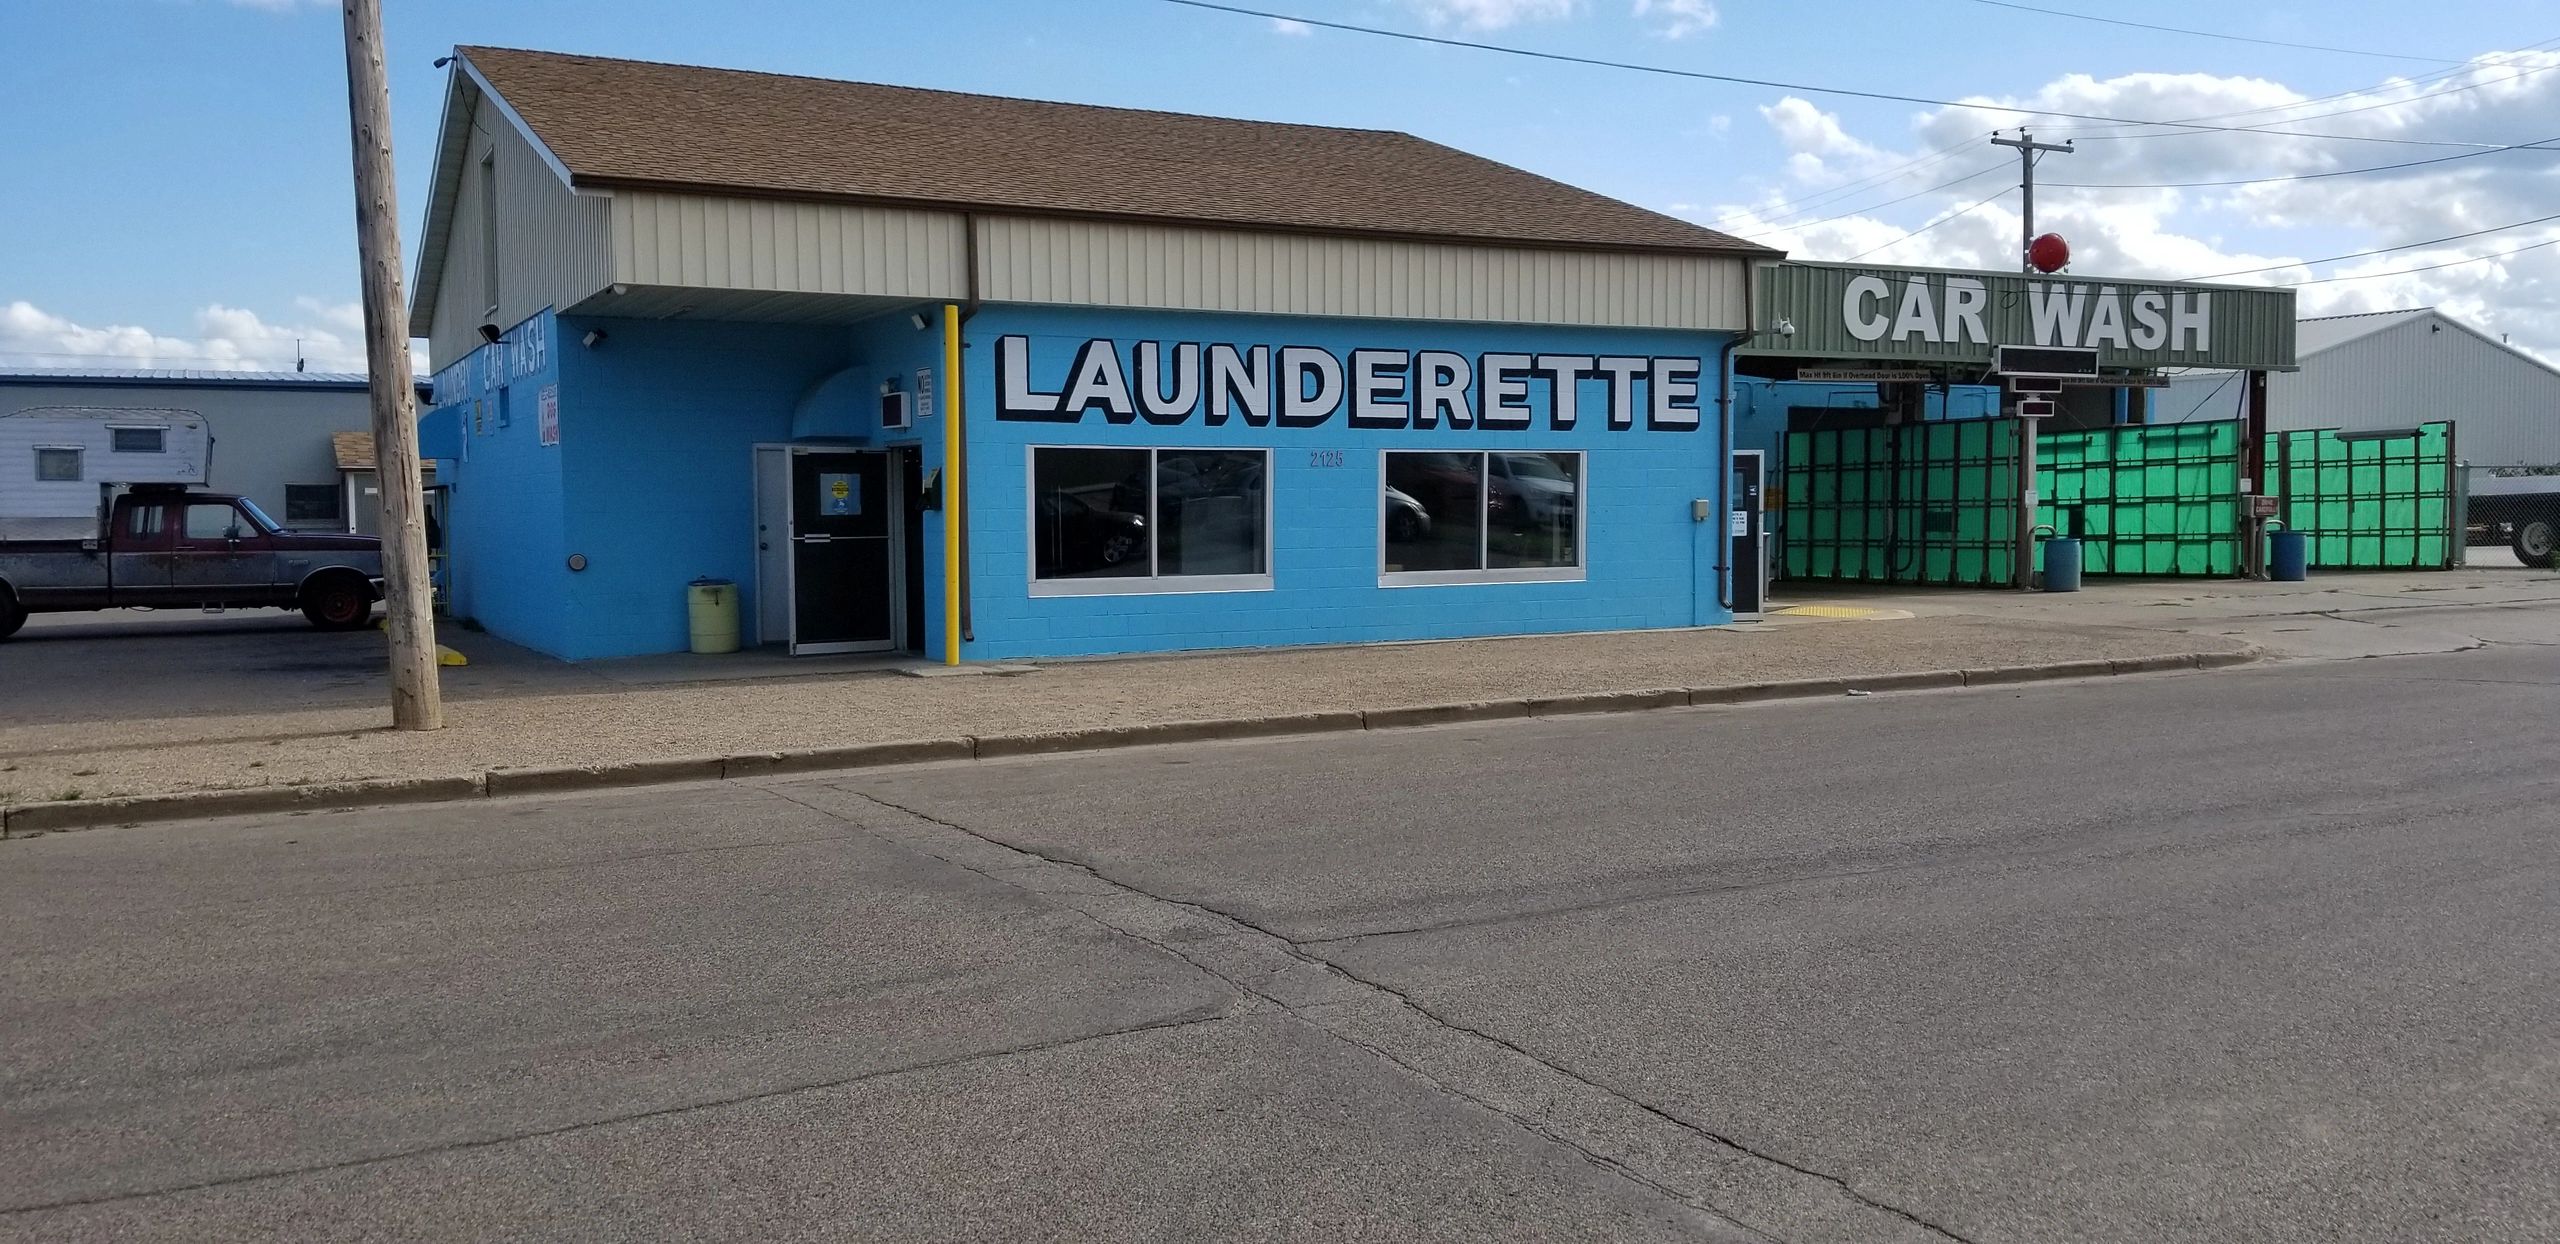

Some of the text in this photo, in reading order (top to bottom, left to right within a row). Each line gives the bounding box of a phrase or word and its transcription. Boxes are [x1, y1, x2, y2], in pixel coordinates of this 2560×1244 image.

[484, 343, 505, 390] CAR
[511, 313, 547, 379] WASH
[1843, 275, 2211, 352] CAR WASH
[995, 335, 1702, 432] LAUNDERETTE
[1311, 448, 1344, 467] 2125
